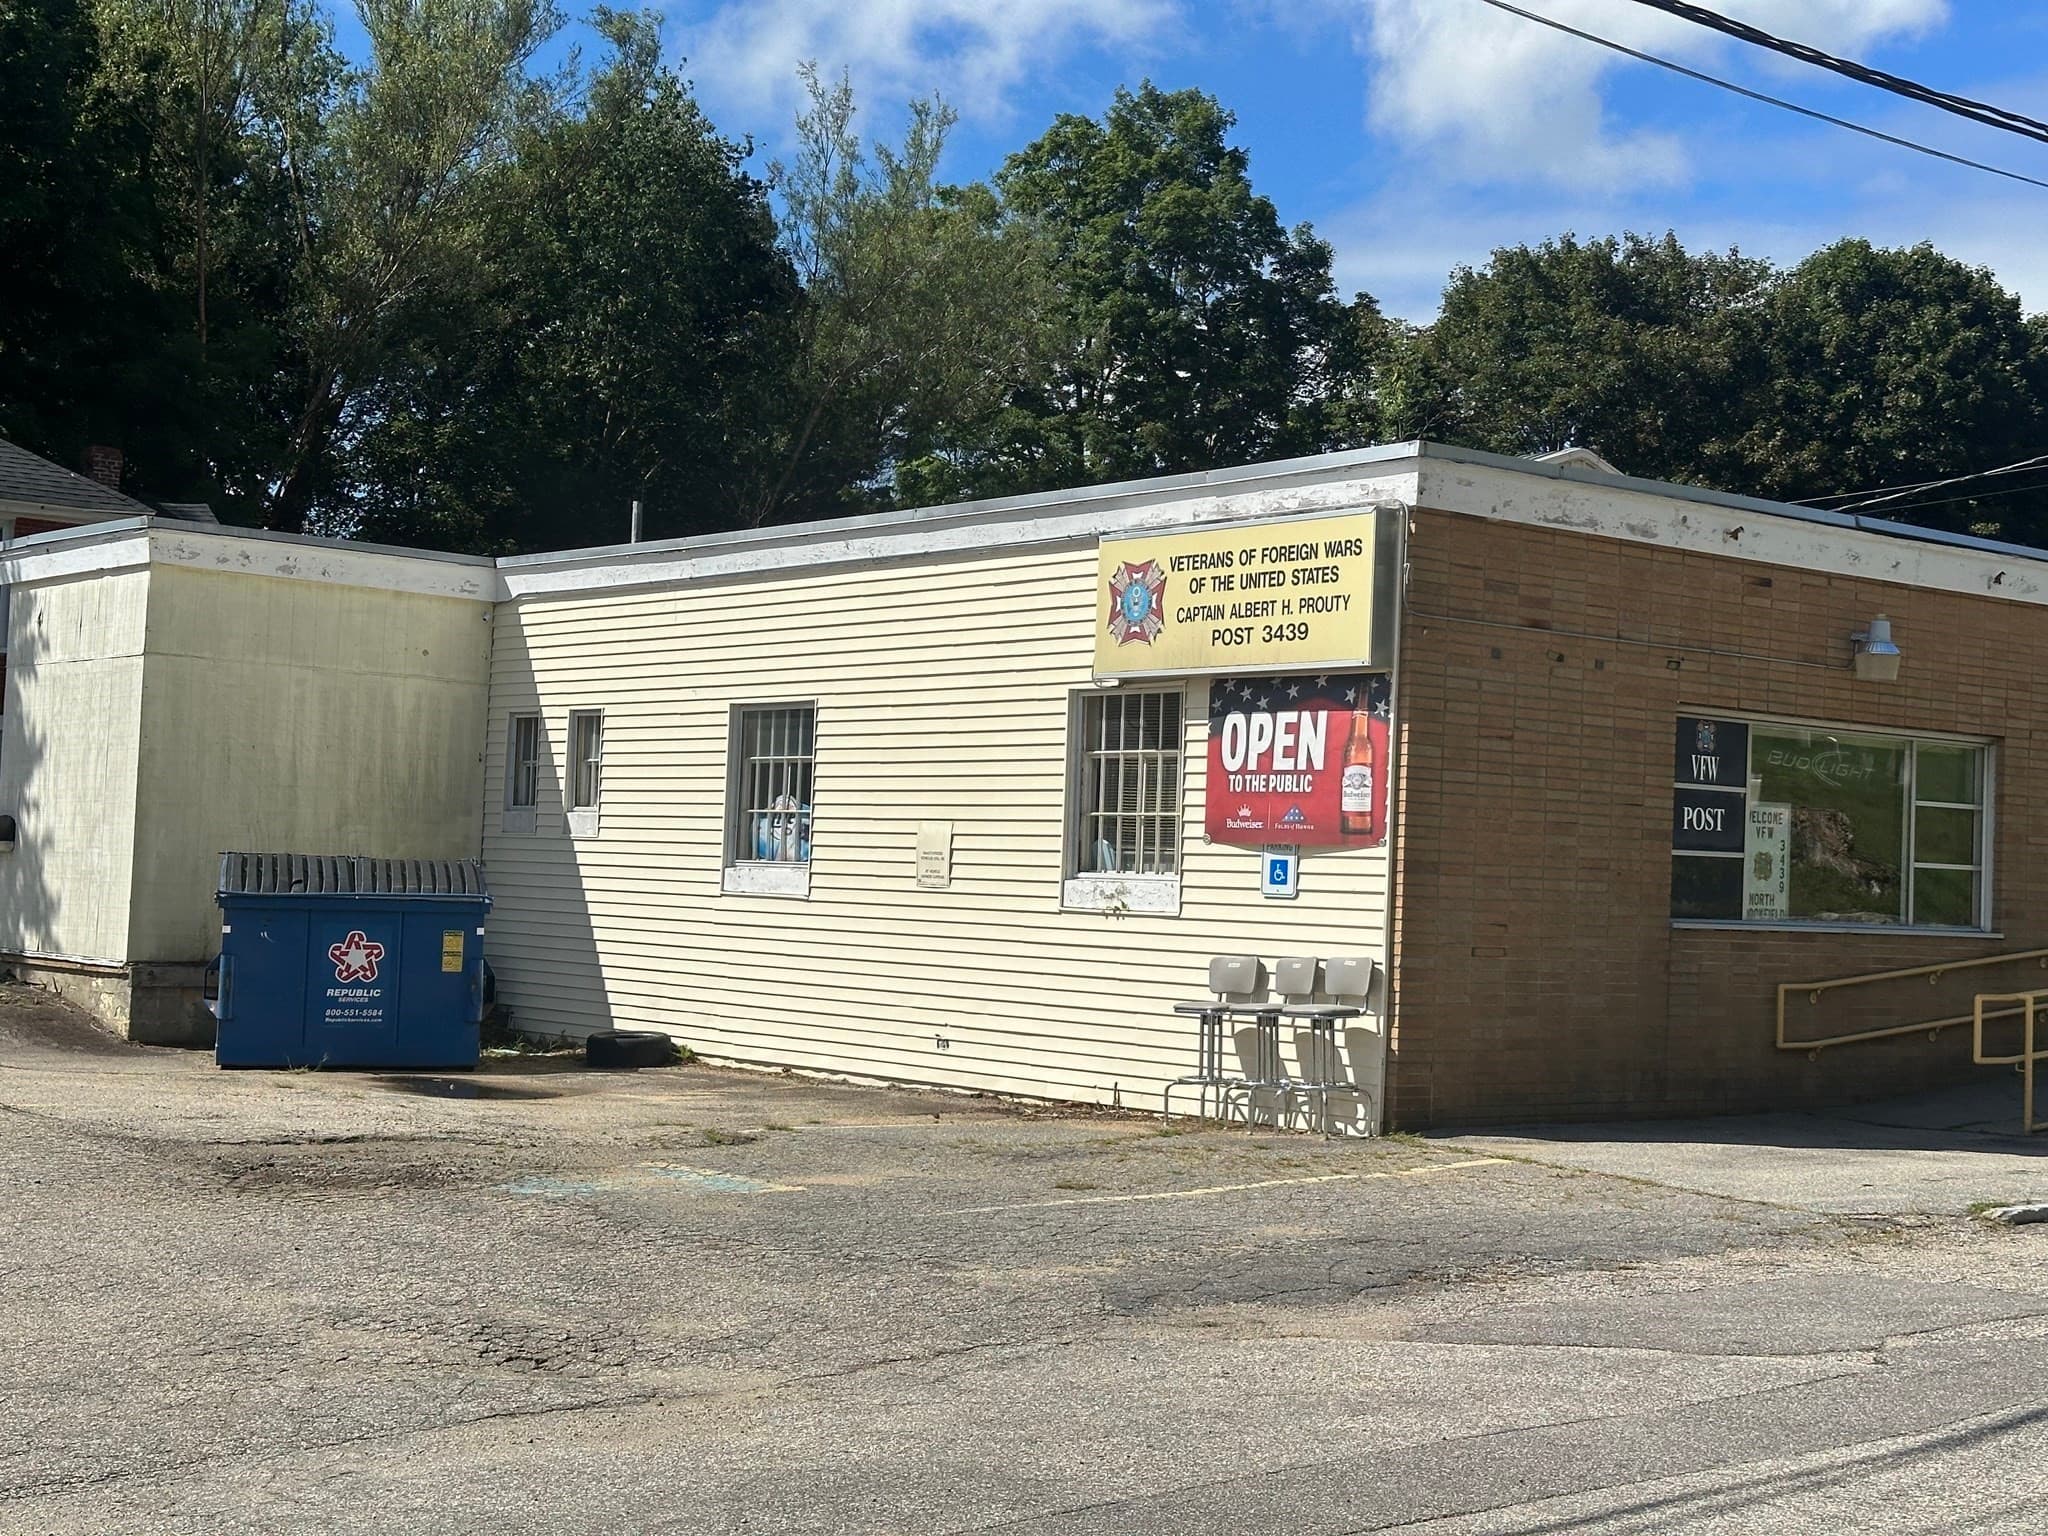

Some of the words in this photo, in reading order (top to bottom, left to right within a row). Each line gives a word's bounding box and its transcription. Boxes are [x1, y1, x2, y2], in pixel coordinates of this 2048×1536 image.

[1169, 551, 1234, 572] VETERANS
[1239, 549, 1256, 566] OF
[1261, 543, 1318, 564] FOREIGN
[1324, 538, 1362, 558] WARS
[1189, 577, 1206, 594] OF
[1211, 575, 1234, 592] THE
[1240, 570, 1285, 590] UNITED
[1291, 565, 1339, 586] STATES
[1177, 604, 1225, 623] CAPTAIN
[1230, 600, 1277, 619] ALBERT
[1282, 599, 1293, 615] H.
[1300, 594, 1351, 614] PROUTY
[1212, 627, 1254, 646] POST
[1262, 622, 1309, 643] 3439
[1221, 710, 1328, 772] OPEN
[1691, 754, 1720, 782] VFW
[1767, 750, 1810, 769] BUD
[1820, 760, 1875, 779] LIGHT
[1228, 775, 1242, 792] TO
[1245, 775, 1266, 792] THE
[1268, 774, 1312, 792] PUBLIC
[1226, 818, 1264, 829] Budweiser
[1682, 806, 1725, 831] POST
[1756, 826, 1774, 839] VFW
[1749, 893, 1775, 906] NORTH
[326, 988, 381, 997] REPUBLIC
